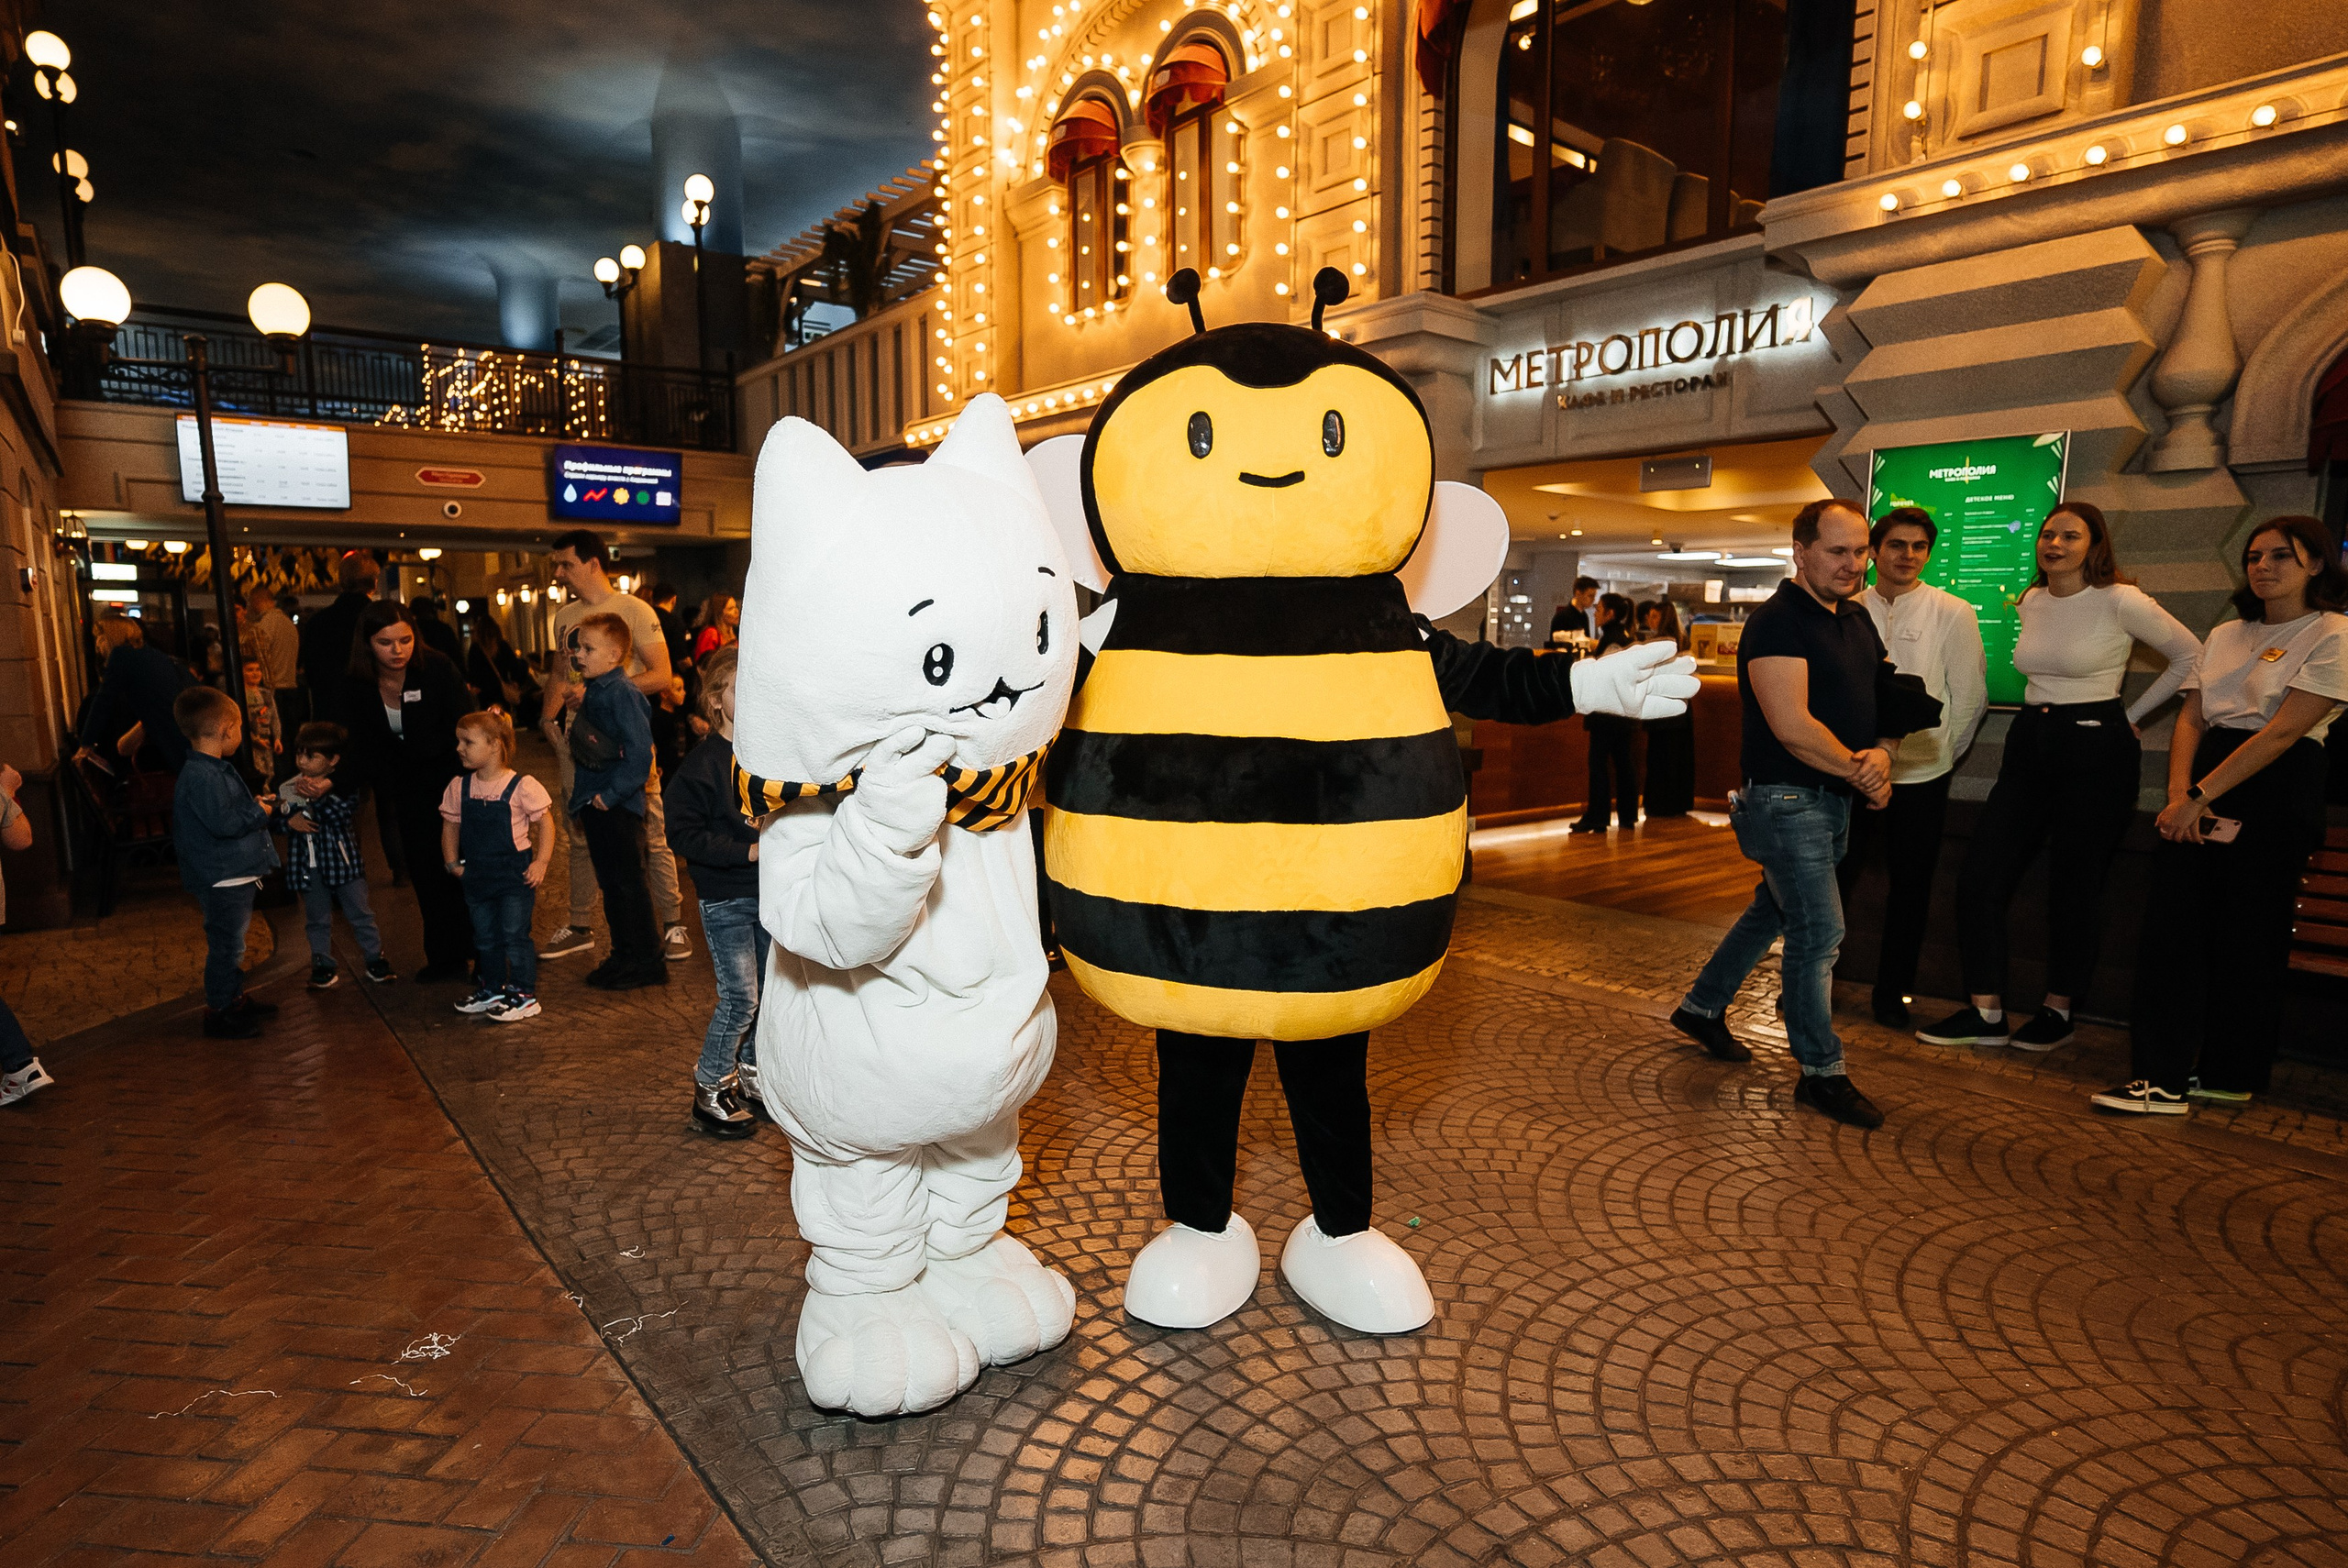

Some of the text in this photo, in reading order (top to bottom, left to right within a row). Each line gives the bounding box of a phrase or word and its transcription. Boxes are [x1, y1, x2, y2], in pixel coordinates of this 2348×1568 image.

[1490, 296, 1813, 395] МЕТРОПОЛИЯ
[1556, 371, 1729, 410] КАФЕ И РЕСТОРАН
[1928, 464, 1997, 480] МЕТРОПОЛИЯ
